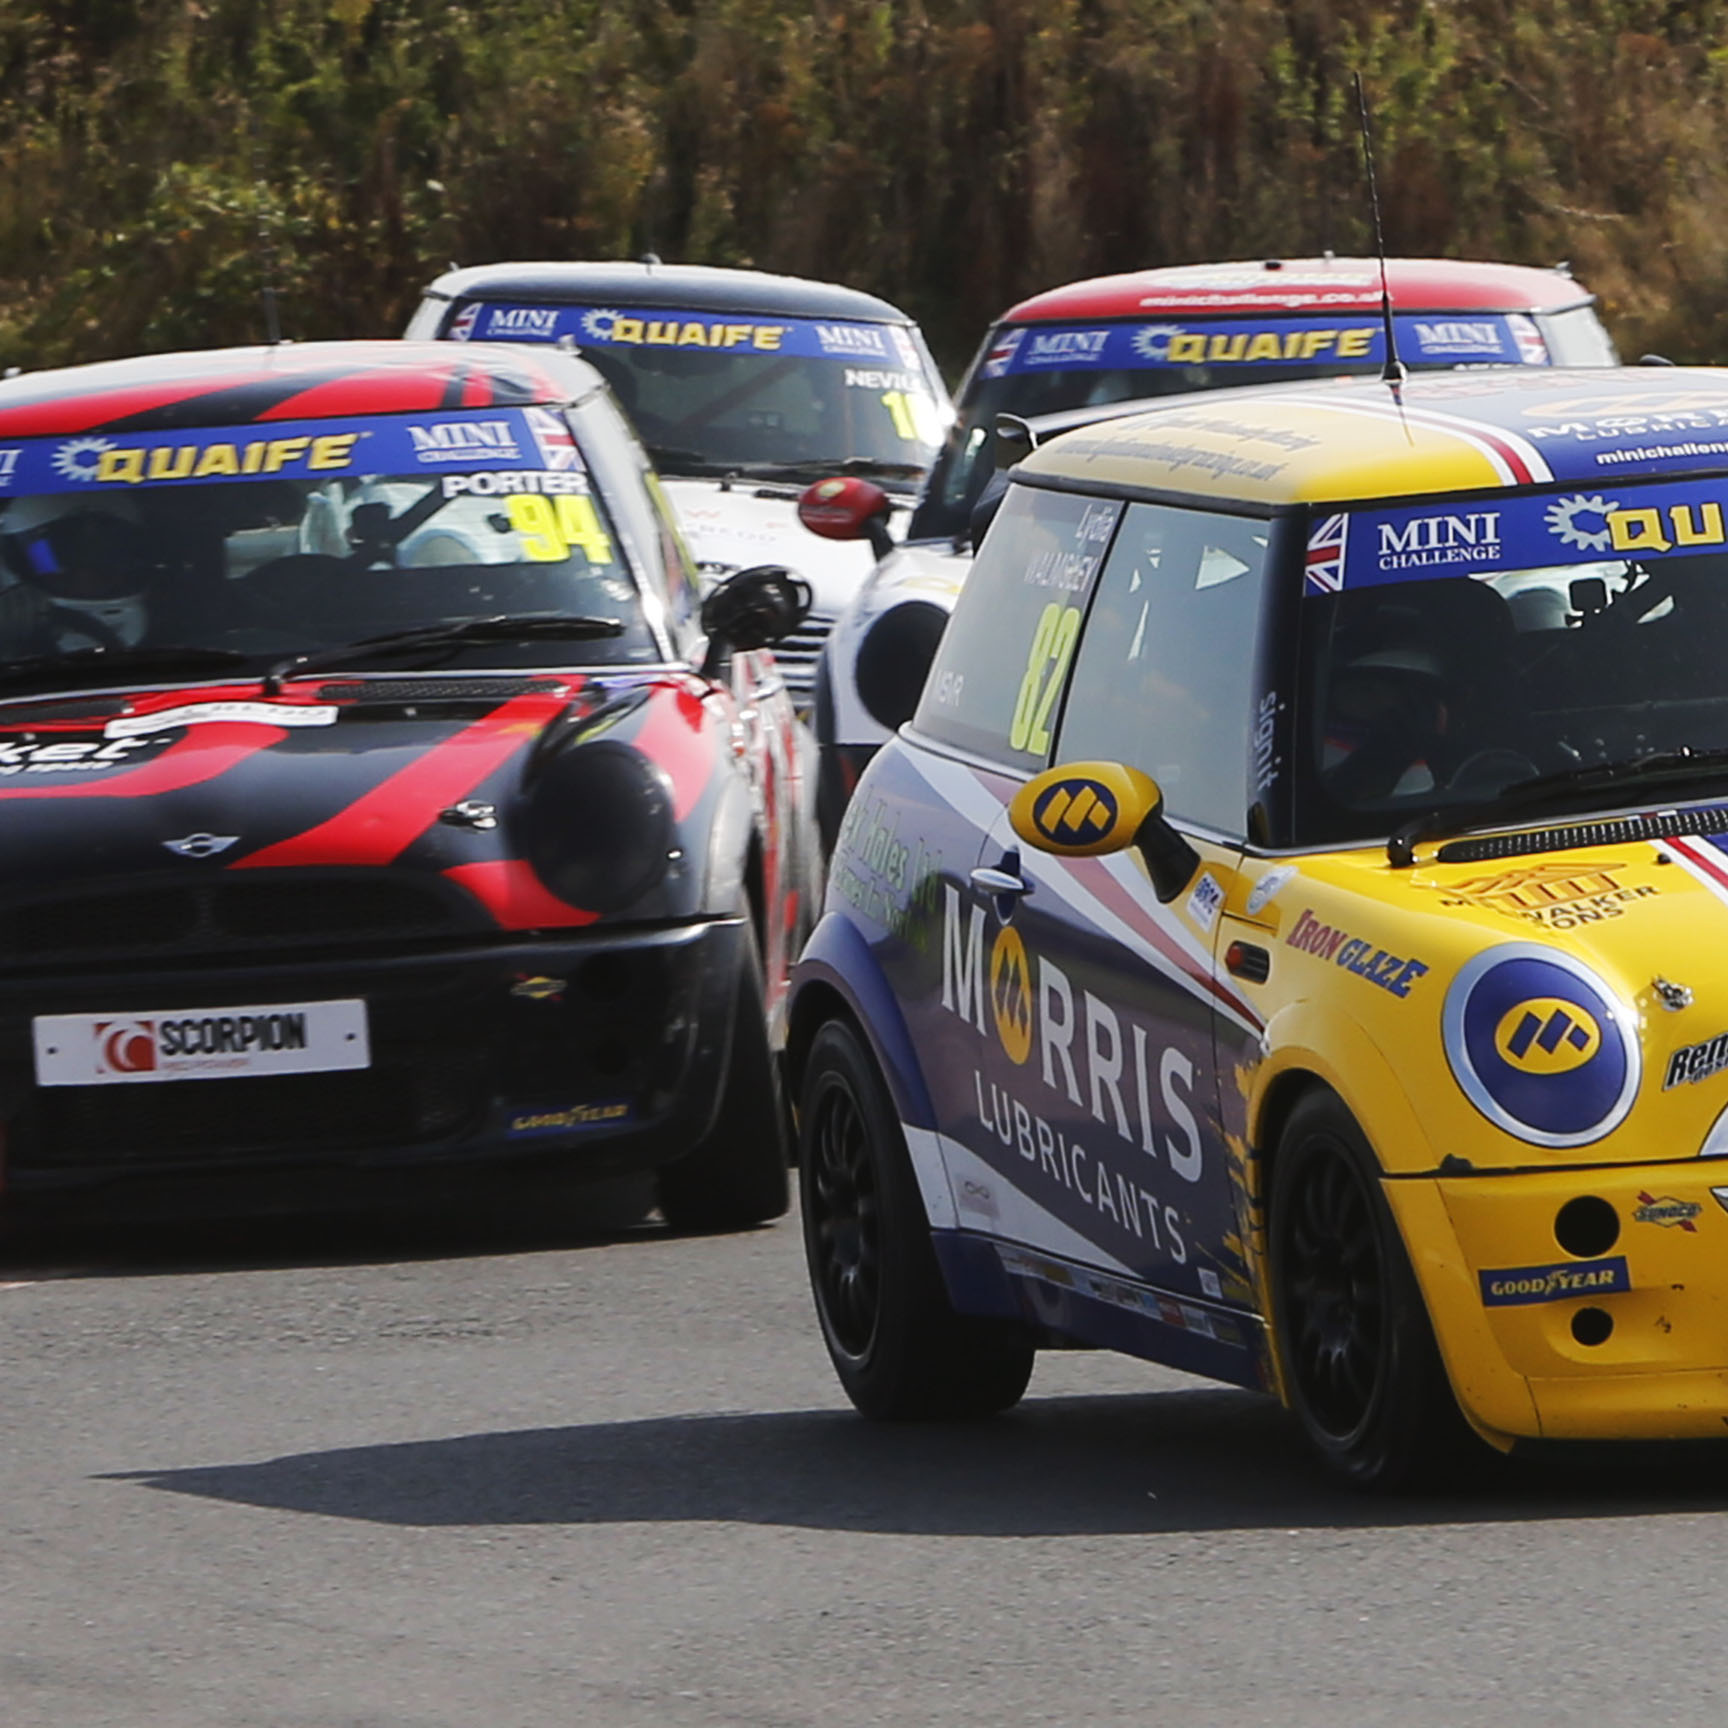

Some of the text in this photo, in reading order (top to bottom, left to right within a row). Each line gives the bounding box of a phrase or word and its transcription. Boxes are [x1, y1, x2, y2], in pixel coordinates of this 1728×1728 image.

[489, 309, 560, 330] MINI
[611, 319, 784, 350] QUAIFE
[1413, 322, 1502, 346] MINI
[813, 325, 884, 349] MINI
[1030, 330, 1112, 355] MINI
[1167, 328, 1375, 364] QUAIFE
[406, 421, 518, 451] MINI
[97, 432, 361, 485] QUAIFE
[442, 471, 591, 498] PORTER
[503, 493, 613, 565] 94
[1377, 512, 1502, 555] MINI
[1379, 545, 1502, 571] CHALLENGE
[1009, 602, 1082, 757] 82
[1284, 908, 1430, 999] IRON GLAZE
[158, 1012, 307, 1056] SCORPION
[974, 1069, 1189, 1265] LUBRICANTS
[1490, 1268, 1615, 1296] GOODYEAR
